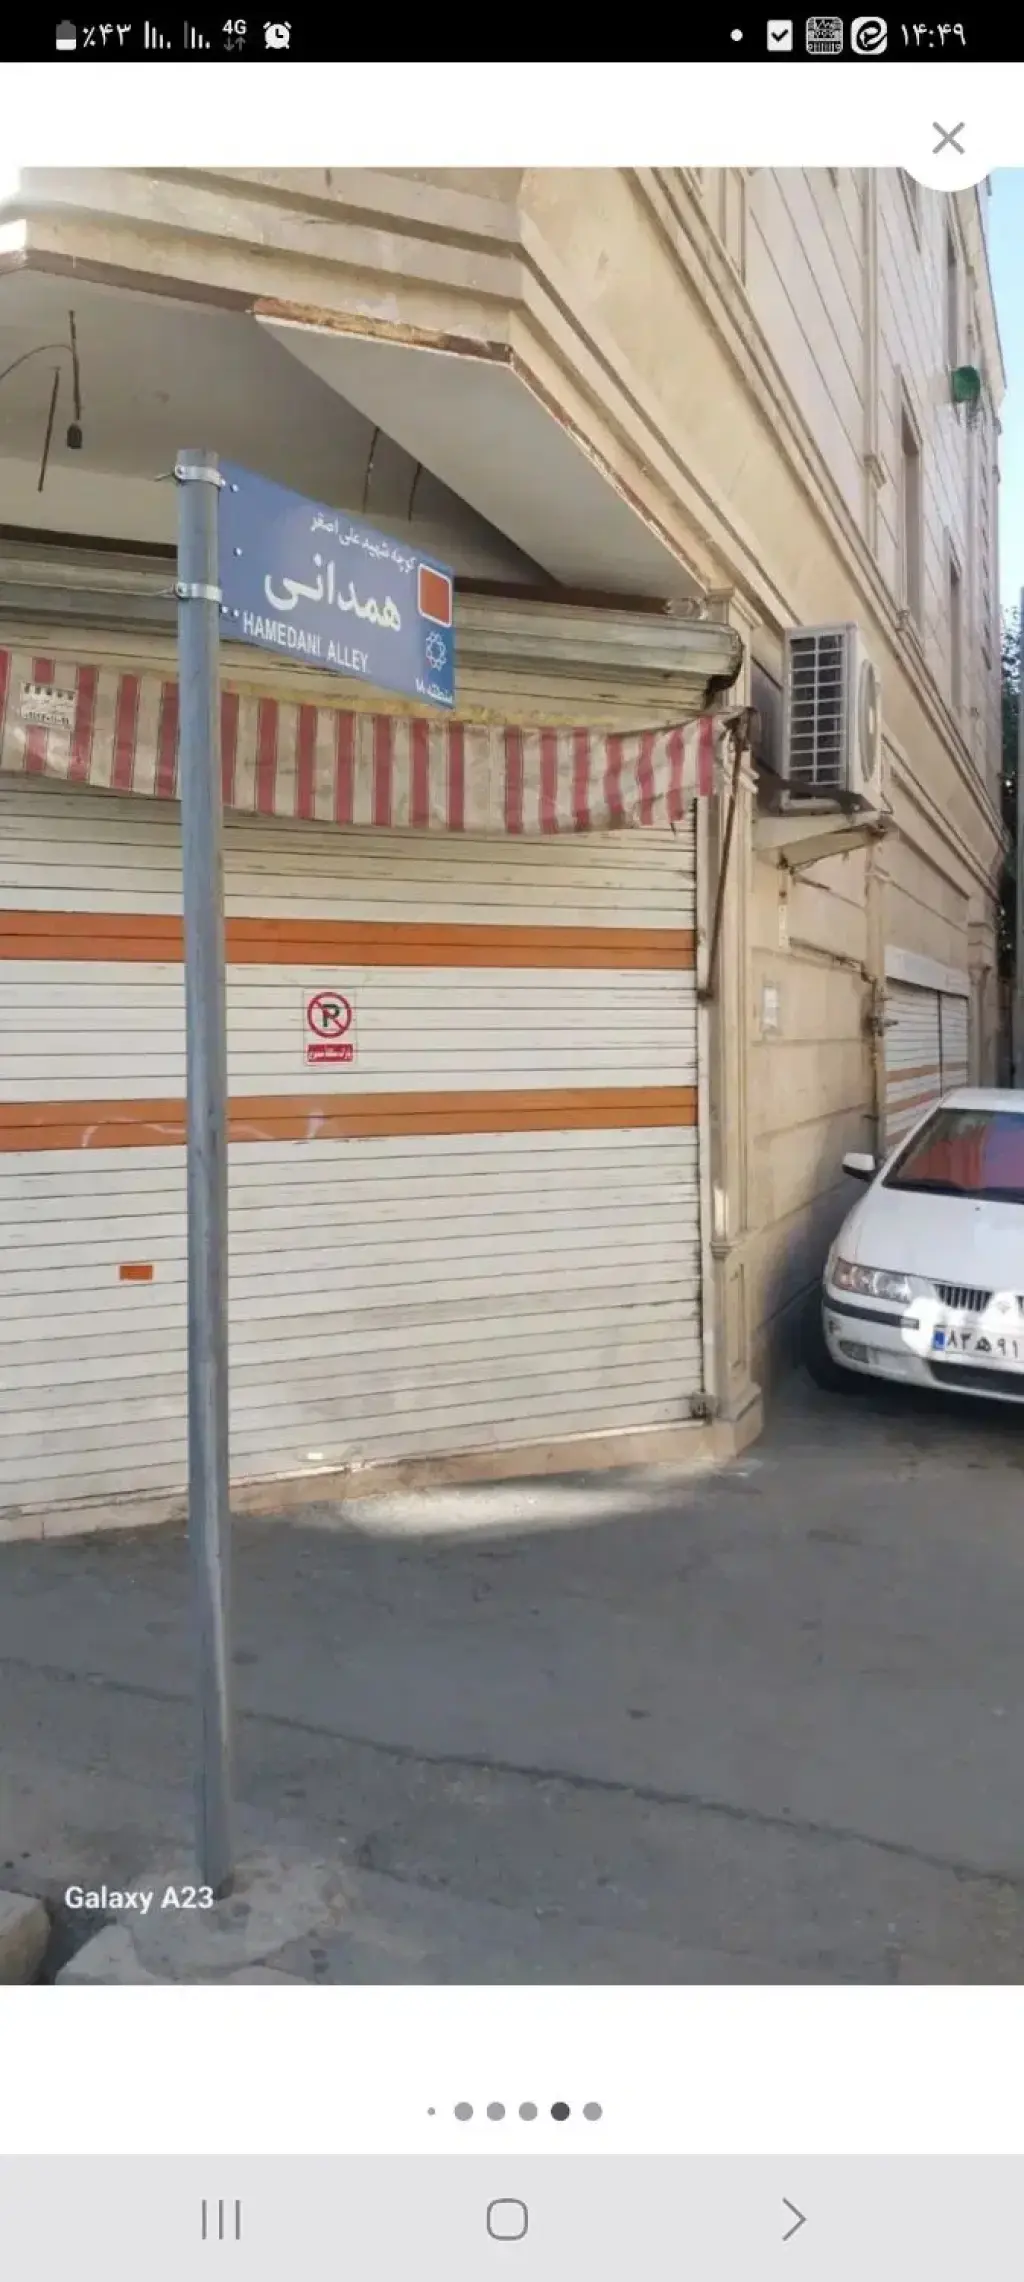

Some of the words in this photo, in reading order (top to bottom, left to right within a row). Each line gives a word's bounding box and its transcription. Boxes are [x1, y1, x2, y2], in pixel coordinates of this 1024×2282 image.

[222, 19, 247, 35] 4G
[901, 23, 966, 47] ۱۴:۴۹
[310, 511, 339, 534] اصغر
[339, 526, 361, 546] علی
[362, 538, 390, 560] شهید
[391, 548, 417, 574] کوچه
[264, 552, 401, 632] همدانی
[243, 610, 321, 657] HAMEDANI
